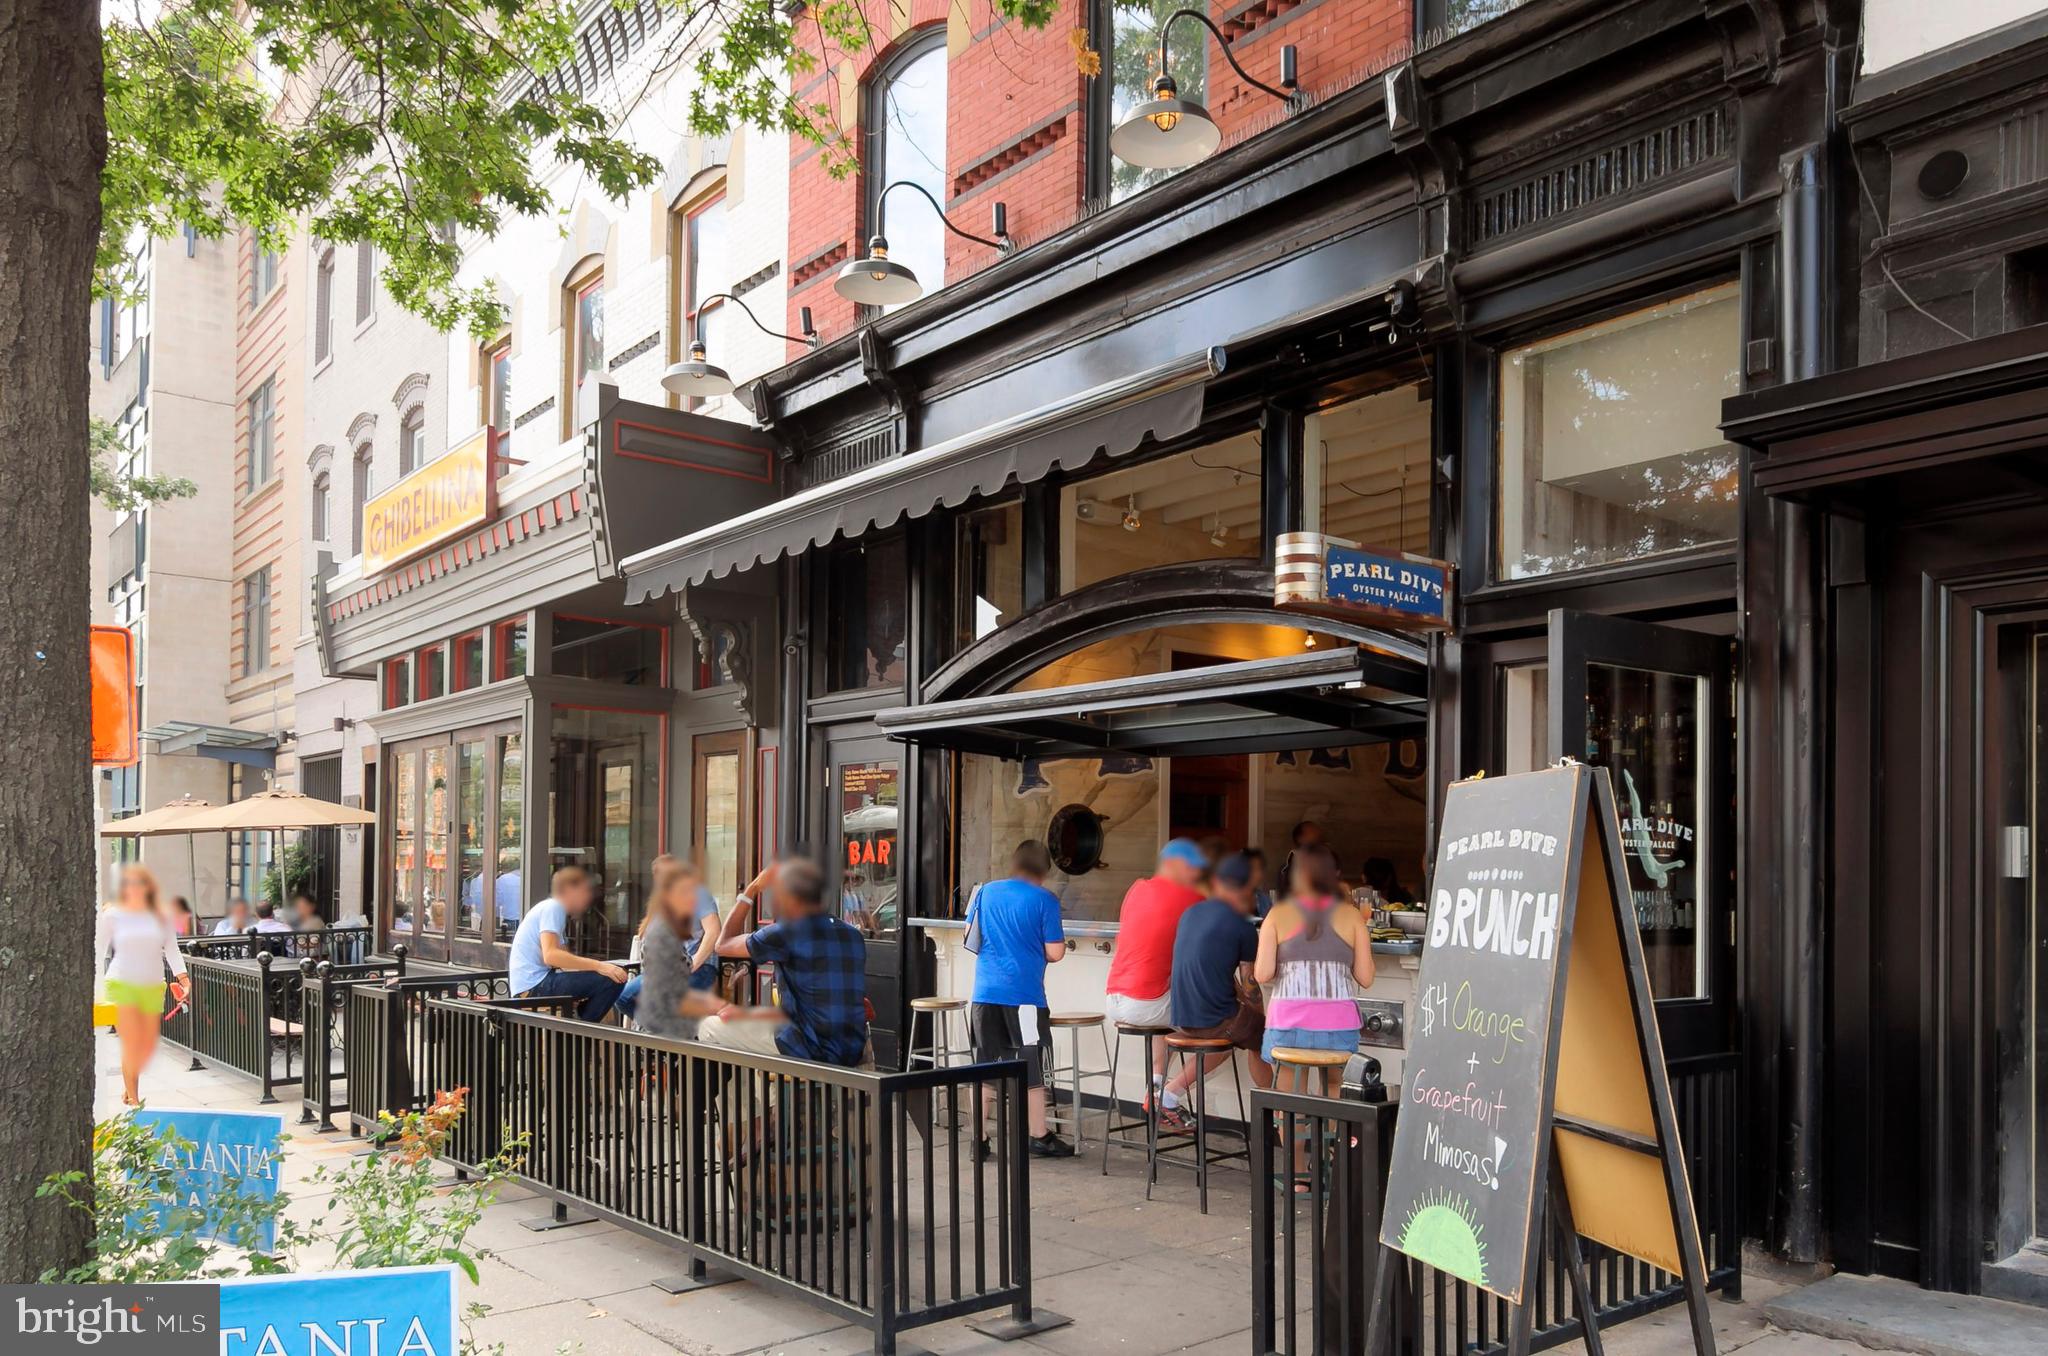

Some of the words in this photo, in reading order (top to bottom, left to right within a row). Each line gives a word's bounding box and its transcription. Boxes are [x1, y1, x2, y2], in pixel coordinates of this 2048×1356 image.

[370, 461, 479, 556] GHIBELLINA
[1330, 562, 1395, 581] PEARL
[1400, 569, 1443, 600] DIVE
[1352, 583, 1385, 598] OYSTER
[1388, 590, 1419, 604] PALACE
[1446, 830, 1505, 861] PEARL
[1508, 828, 1558, 857] DIVE
[1621, 818, 1652, 833] ARL
[1657, 819, 1693, 842] DIVE
[1650, 840, 1676, 849] PALACE
[848, 839, 891, 865] BAR
[1430, 887, 1559, 960] BRUNCH
[1421, 981, 1448, 1037] $4
[1452, 980, 1525, 1064] Orange
[1412, 1068, 1507, 1130] Grapefruit
[159, 1139, 274, 1180] ATANIA
[1424, 1121, 1508, 1191] Mimosas!
